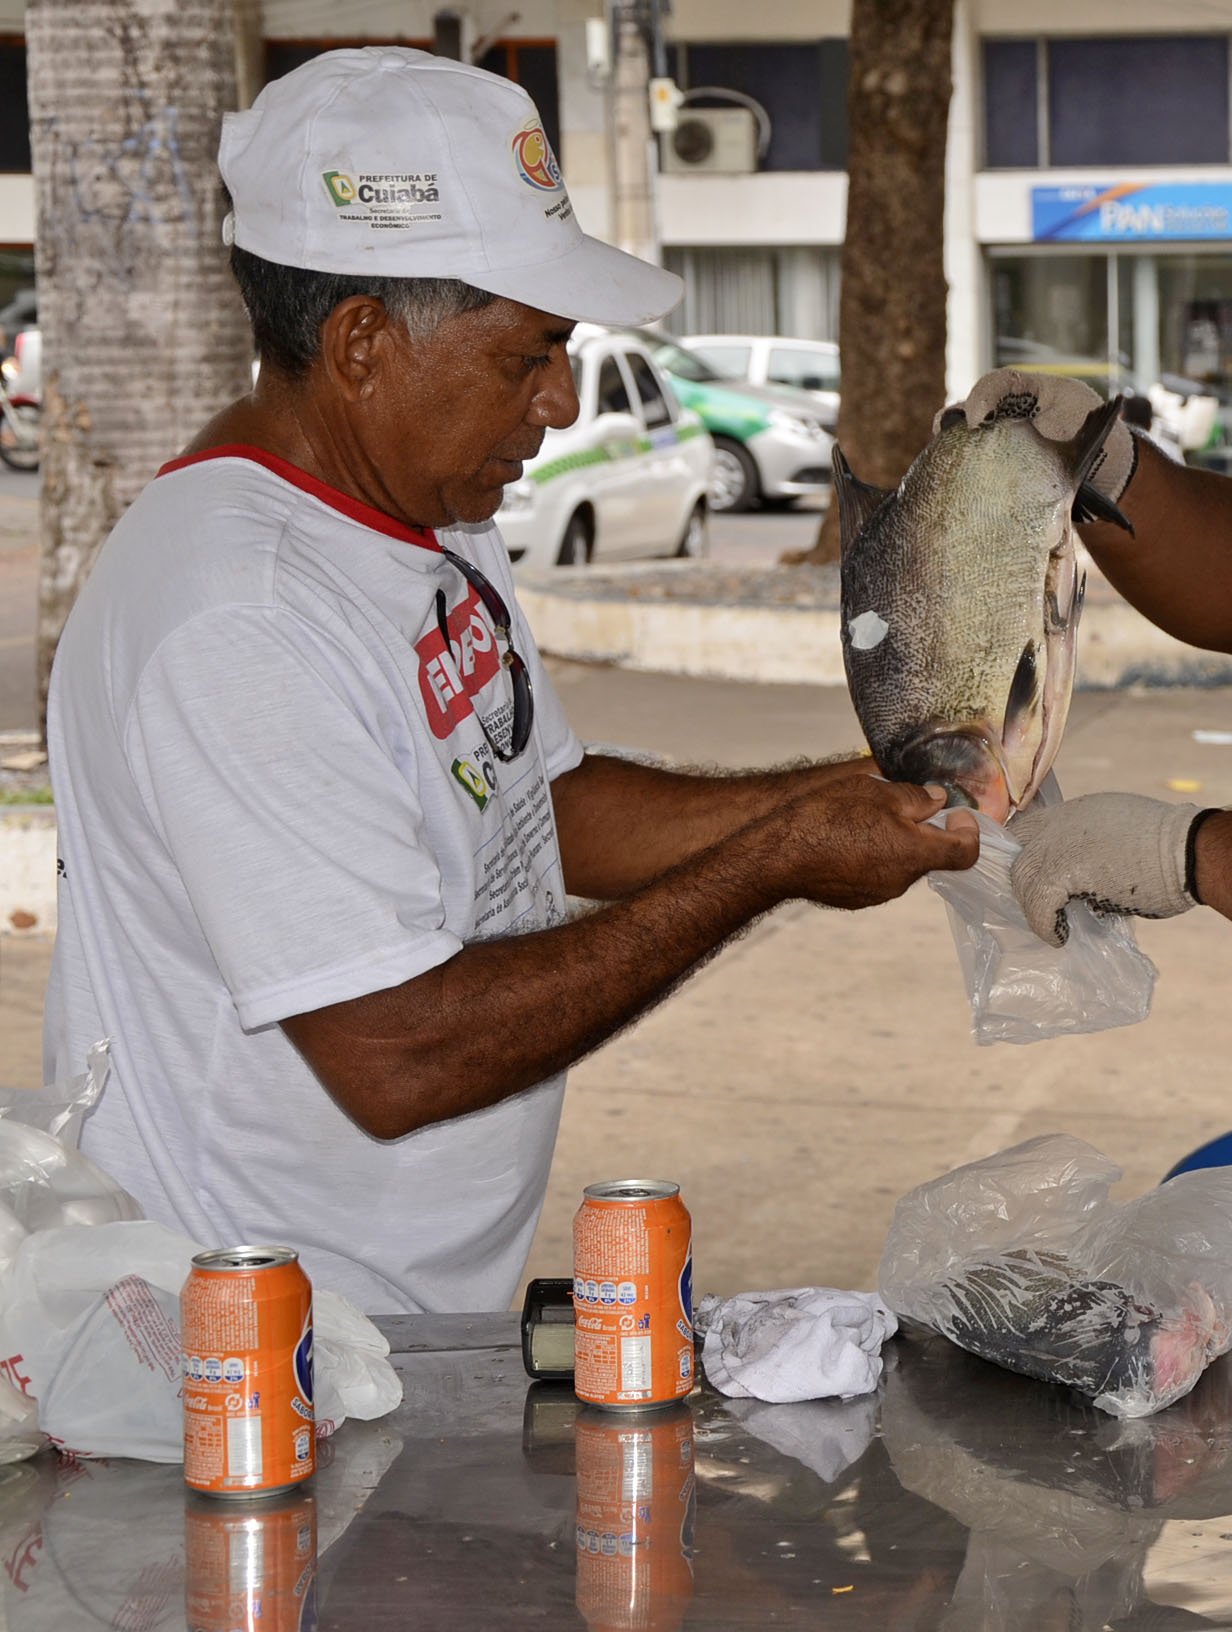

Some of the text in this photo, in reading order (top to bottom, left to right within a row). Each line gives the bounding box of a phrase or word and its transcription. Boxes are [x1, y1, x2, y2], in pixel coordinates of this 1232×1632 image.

[359, 174, 438, 183] PREFEITURA DE
[358, 182, 440, 204] Cuiabá
[1100, 202, 1165, 232] PAN
